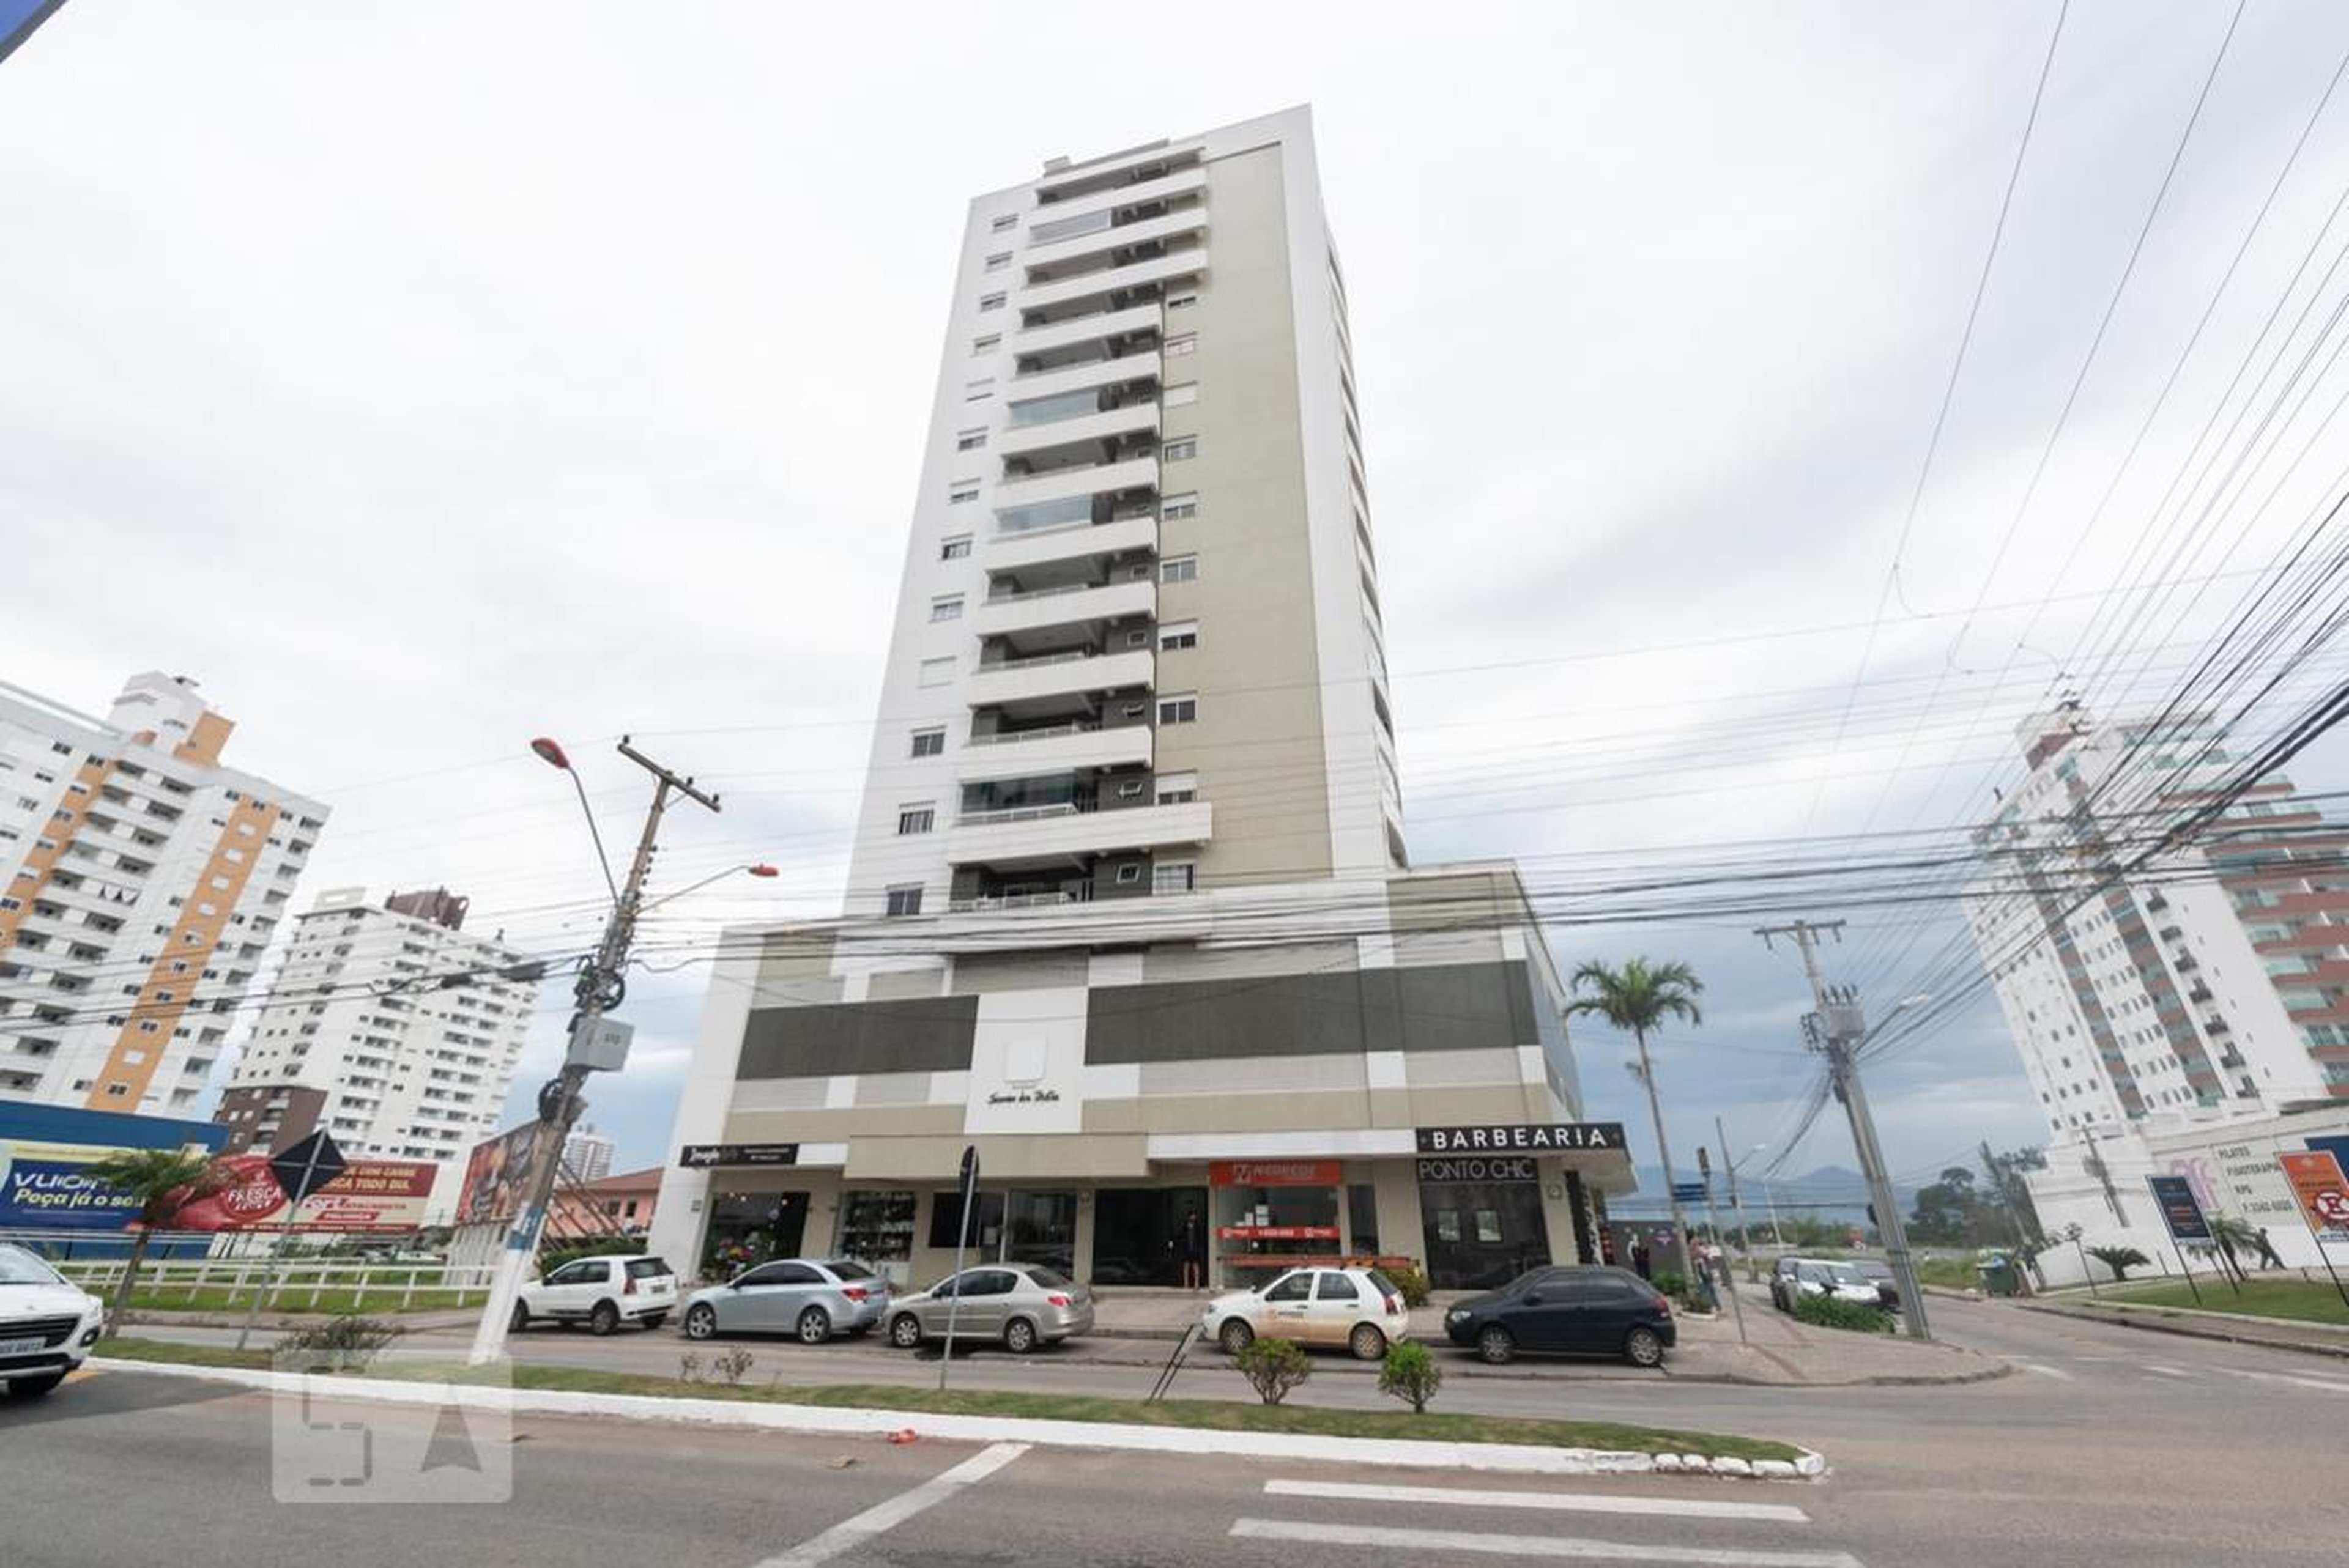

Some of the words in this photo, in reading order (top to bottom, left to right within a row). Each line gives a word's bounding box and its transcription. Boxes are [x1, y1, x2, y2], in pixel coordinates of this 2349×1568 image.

[1433, 1128, 1607, 1149] BARBEARIA
[1418, 1159, 1485, 1180] PONTO
[1490, 1160, 1534, 1179] CHIC
